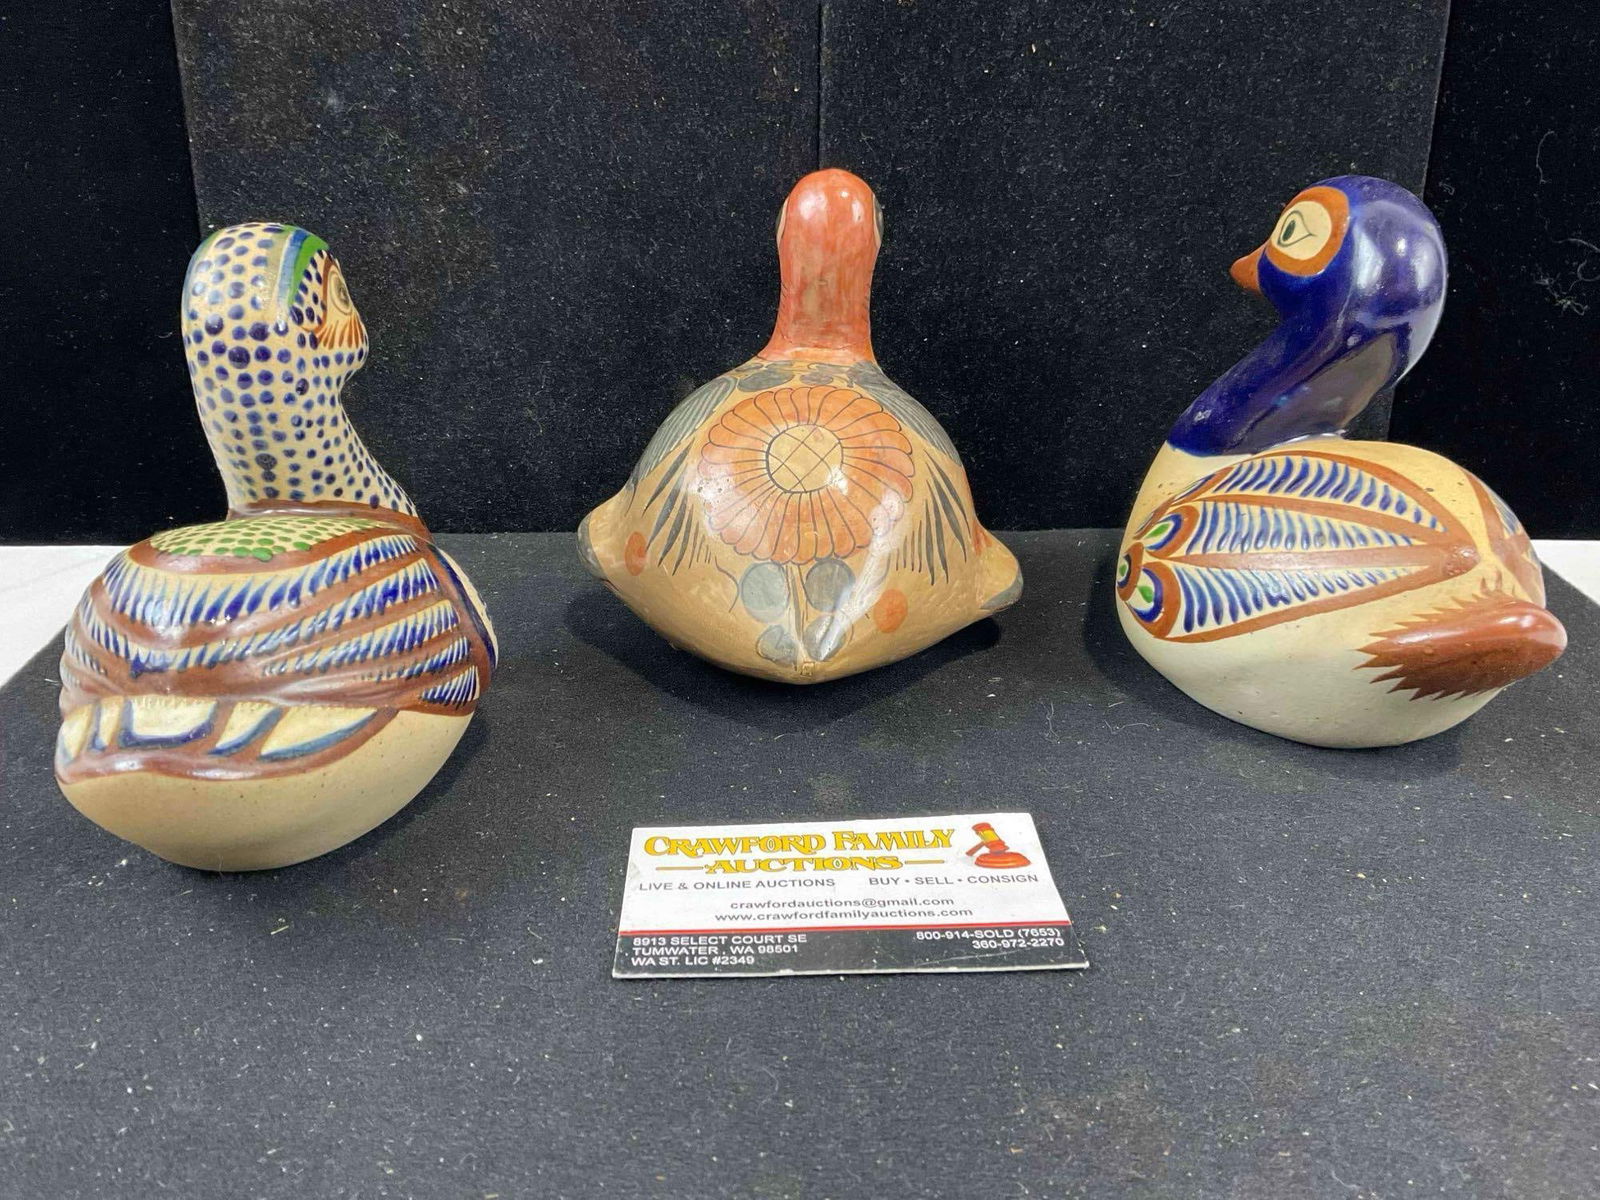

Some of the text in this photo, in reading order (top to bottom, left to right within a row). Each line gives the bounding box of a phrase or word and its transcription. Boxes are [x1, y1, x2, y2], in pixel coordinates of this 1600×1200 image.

[706, 856, 903, 874] AUCTIONS
[639, 878, 836, 891] LIVE & ONLINE AUCTIONS
[869, 874, 1038, 886] BUY SELL CONSIGN
[730, 897, 954, 910] crawfordauctions@gmail.com
[715, 907, 973, 921] www.crawfordfamilyauctions.com
[670, 936, 728, 945] SELECT
[731, 935, 784, 944] COURT
[787, 934, 807, 943] SE
[916, 928, 1061, 940] 800-914-SOLD (7653)
[730, 945, 754, 954] WA
[758, 944, 798, 954] 98501
[972, 938, 1064, 949] 360-972-2270
[631, 955, 755, 966] WA ST. LIC #2349
